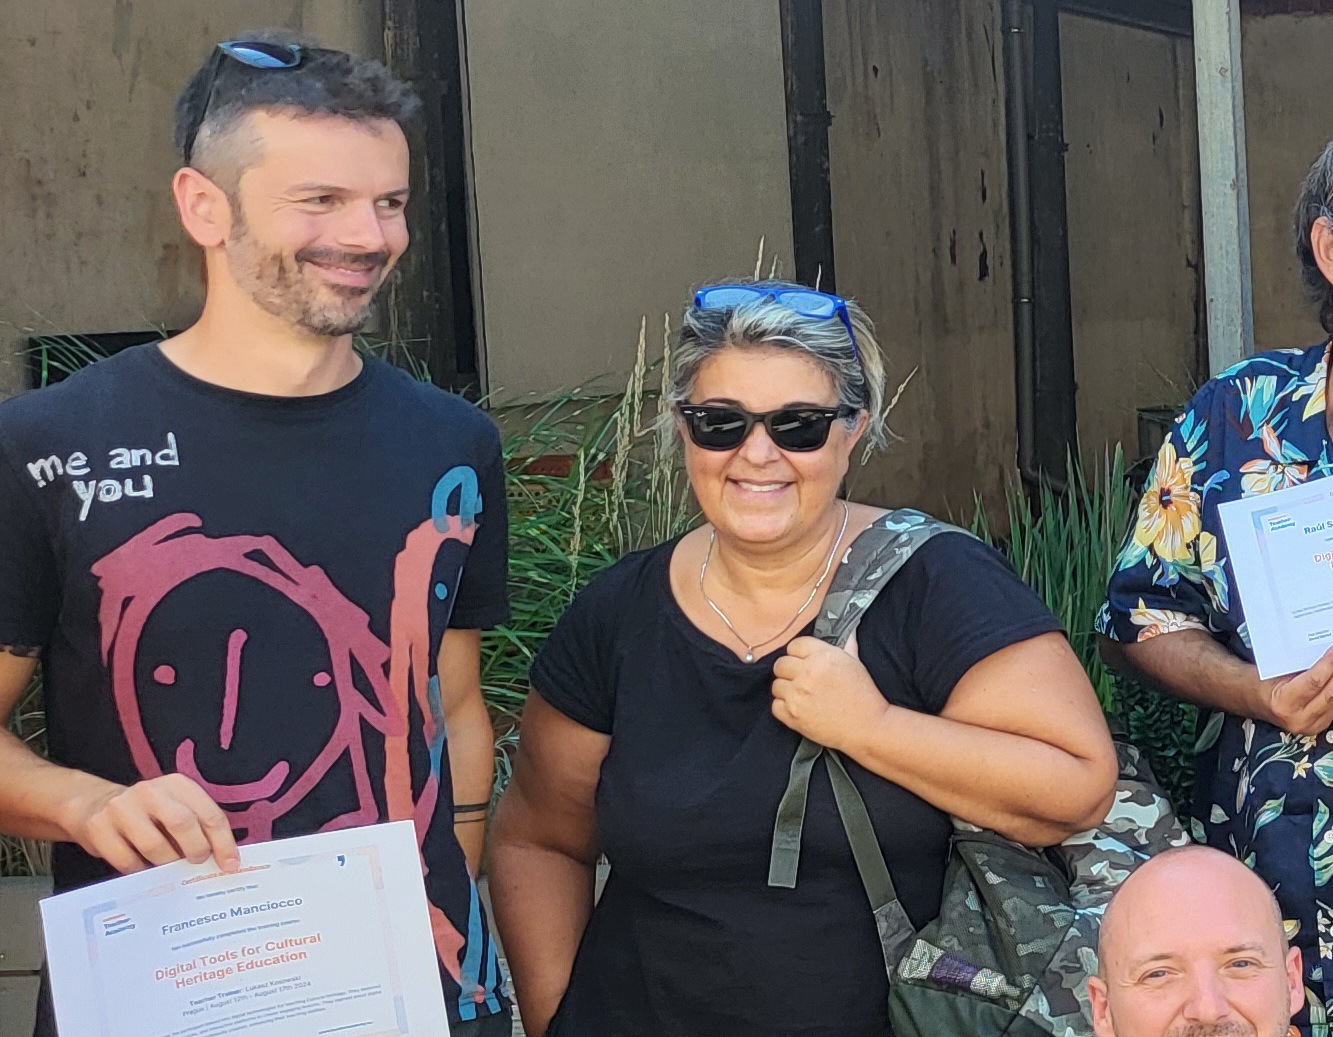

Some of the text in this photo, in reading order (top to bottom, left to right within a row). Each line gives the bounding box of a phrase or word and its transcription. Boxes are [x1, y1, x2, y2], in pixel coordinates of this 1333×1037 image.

[26, 432, 180, 487] me and
[72, 474, 154, 521] you
[162, 912, 227, 935] Francesco
[230, 898, 302, 917] Manciocco
[155, 959, 196, 980] Digital
[199, 951, 238, 966] Tools
[241, 946, 260, 956] for
[265, 933, 321, 951] Cultural
[173, 952, 307, 988] Heritage Education
